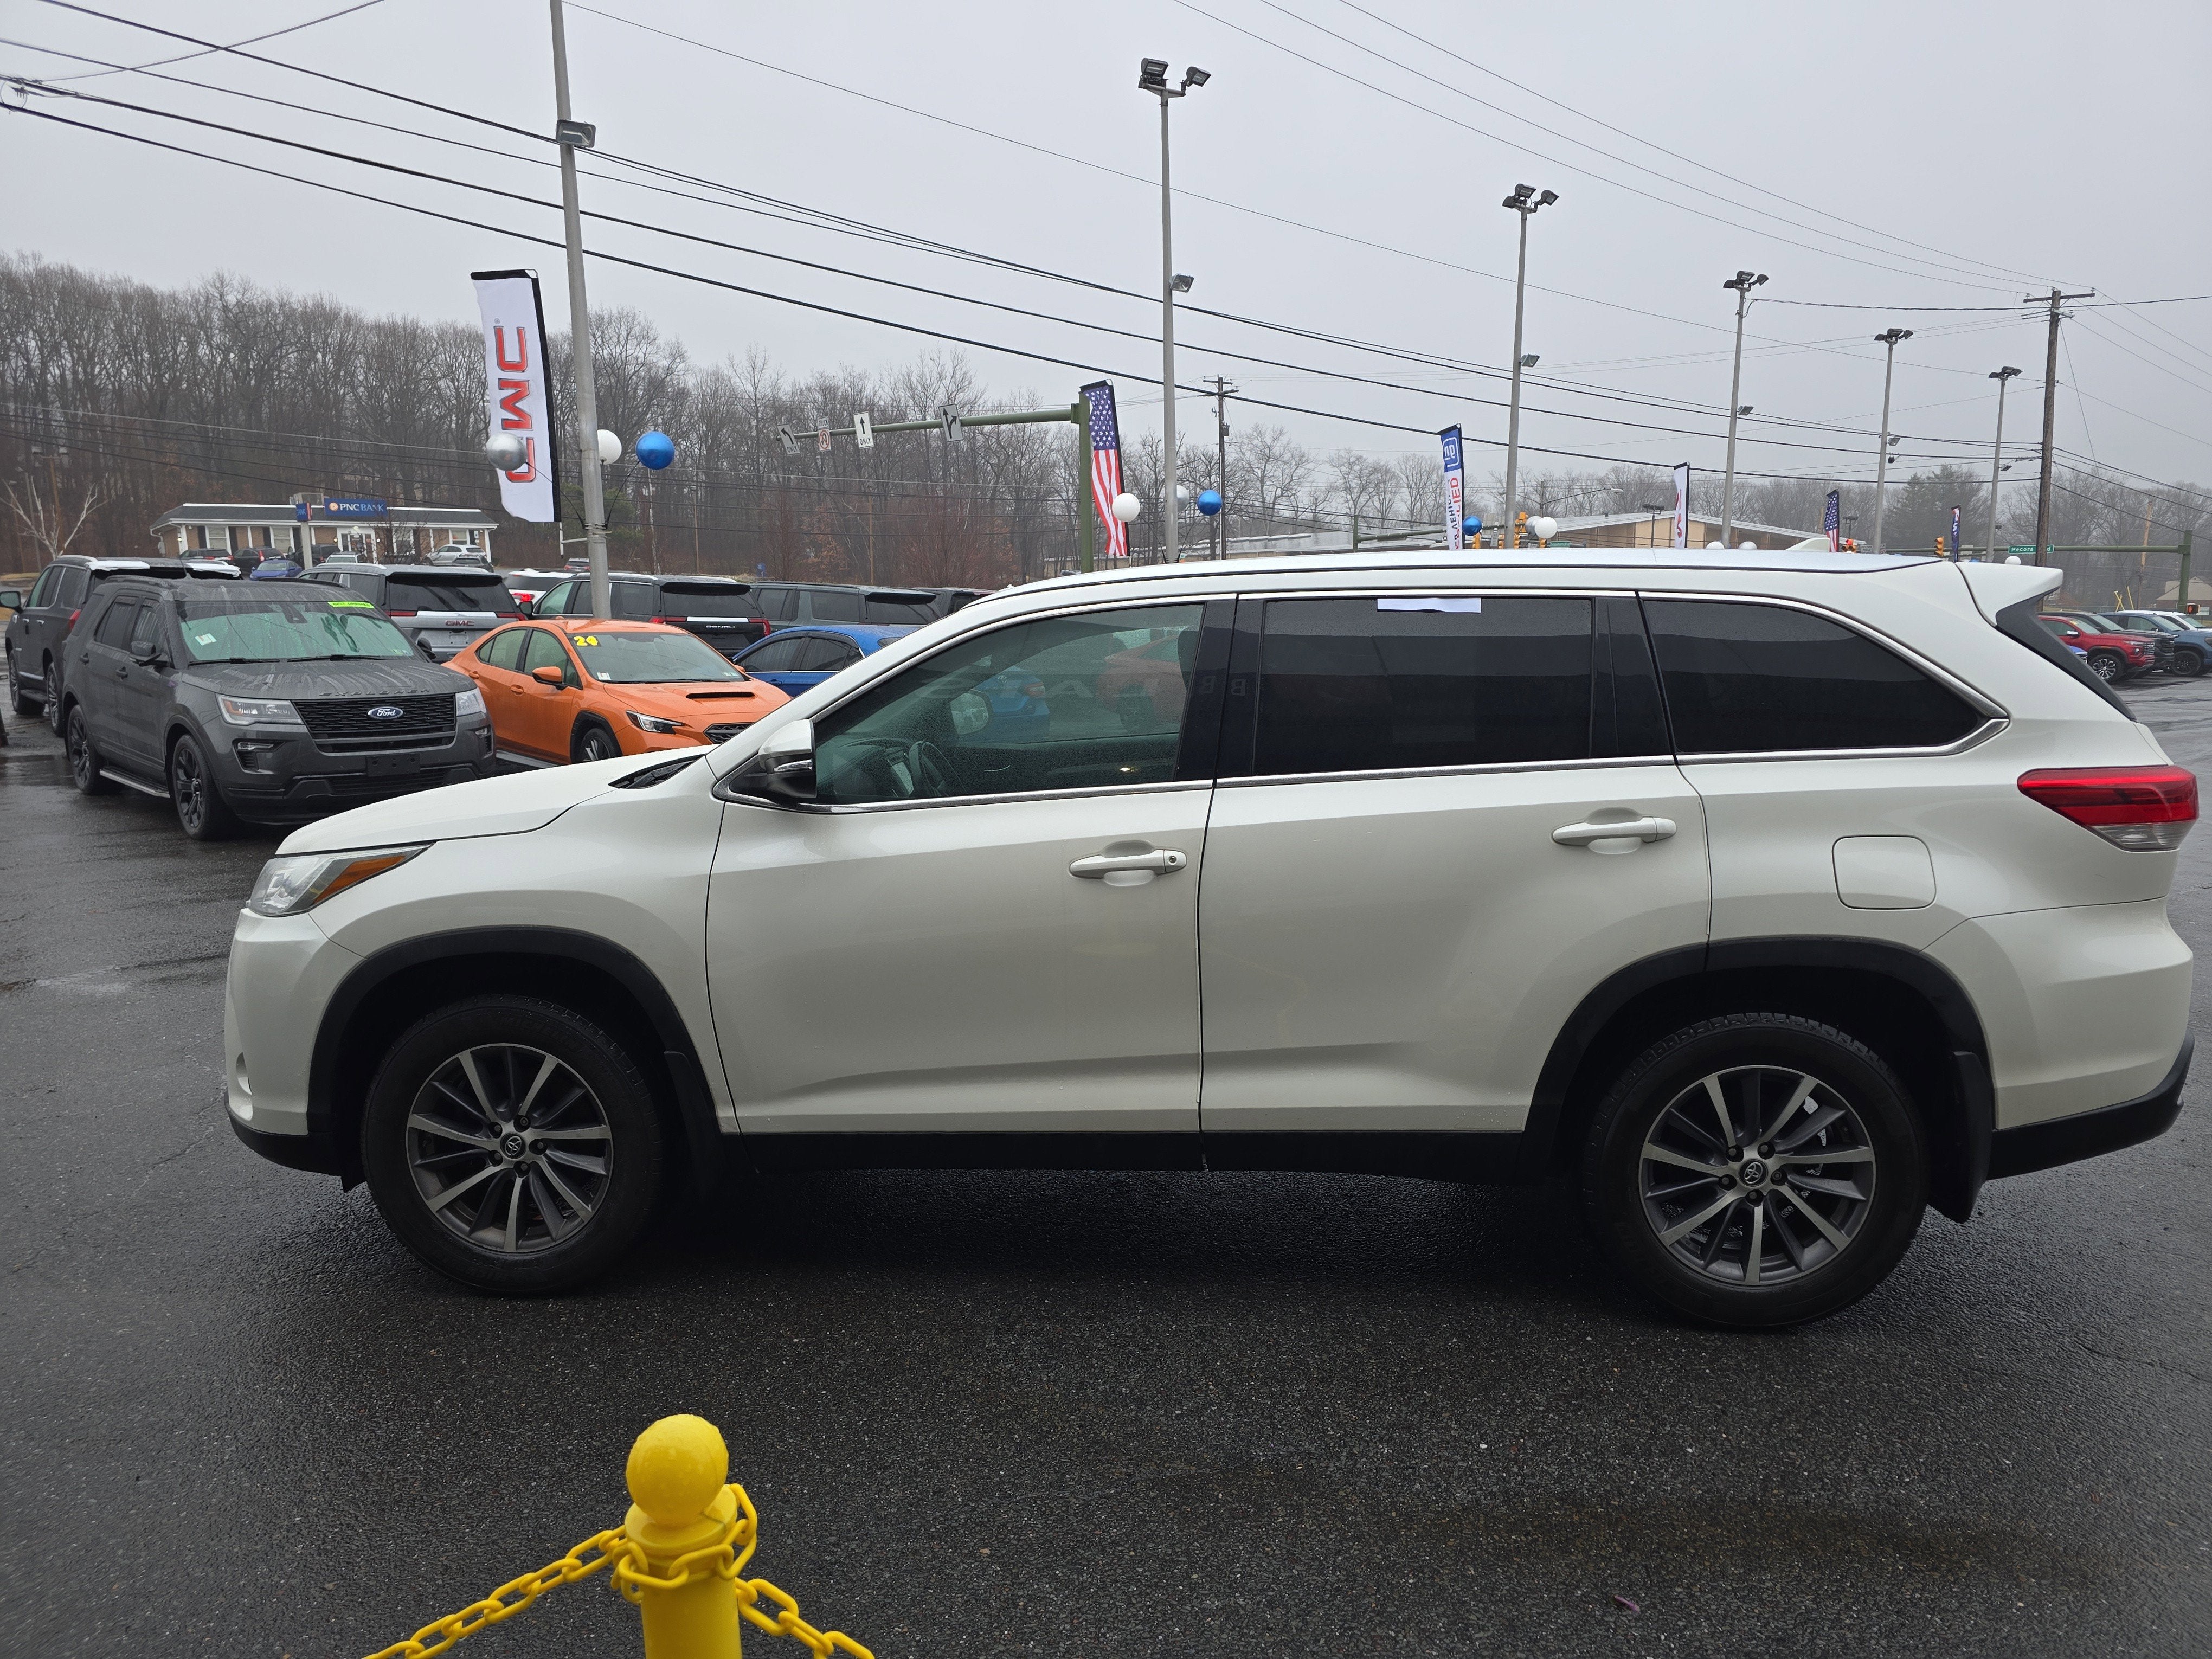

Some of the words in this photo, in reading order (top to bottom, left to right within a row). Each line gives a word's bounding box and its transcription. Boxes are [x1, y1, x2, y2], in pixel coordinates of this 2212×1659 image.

[859, 437, 872, 445] ONLY
[573, 636, 598, 646] 24
[377, 709, 396, 717] Ford
